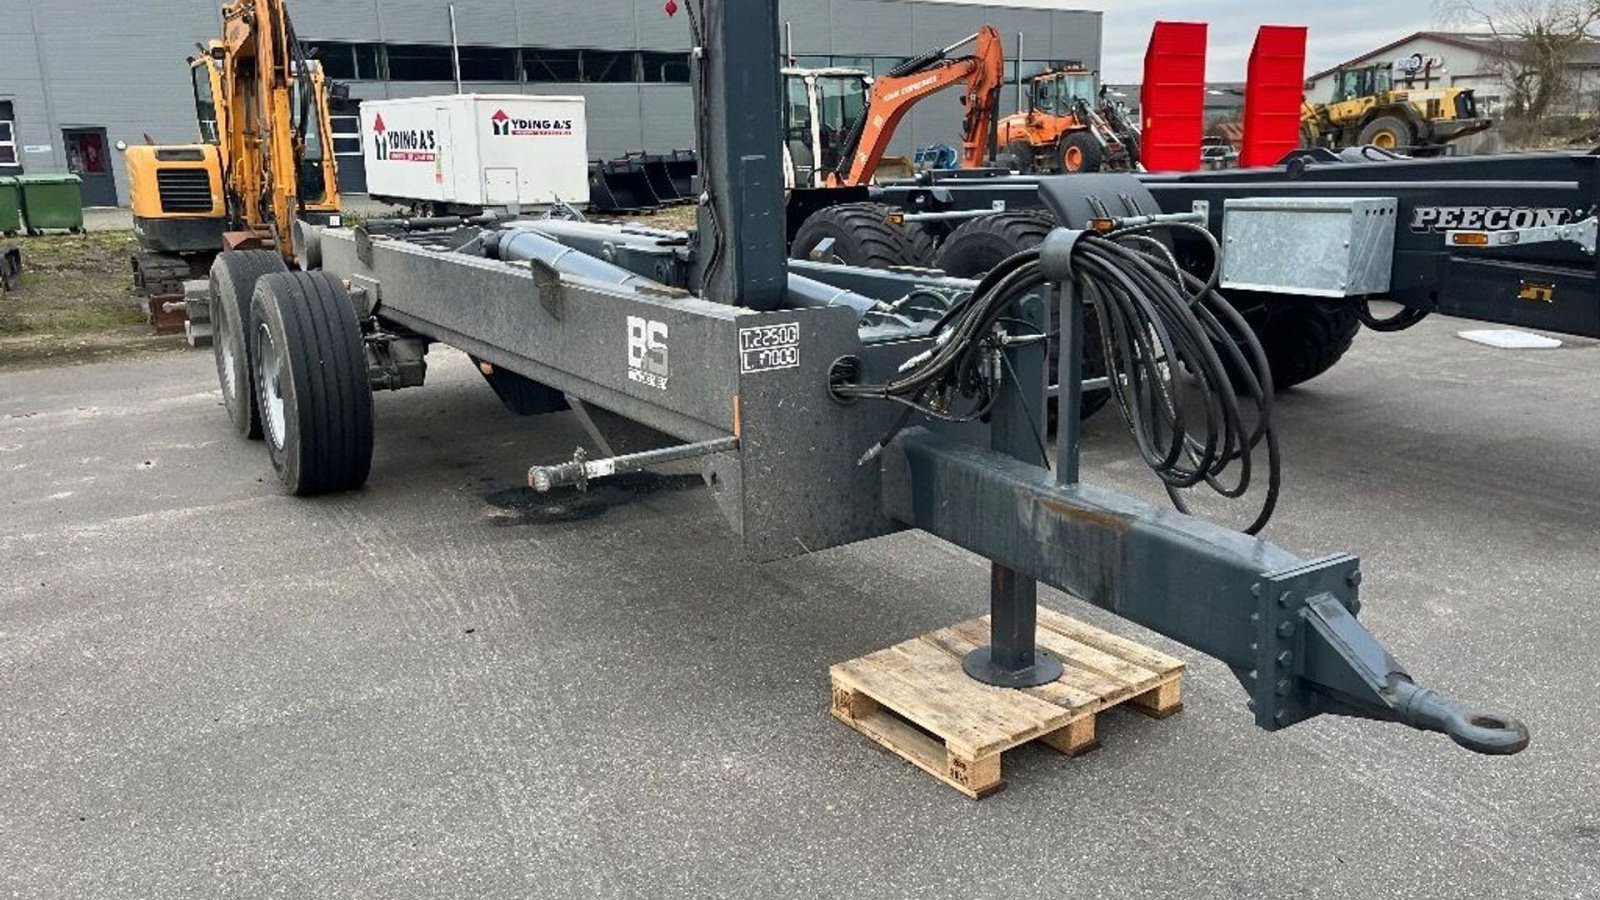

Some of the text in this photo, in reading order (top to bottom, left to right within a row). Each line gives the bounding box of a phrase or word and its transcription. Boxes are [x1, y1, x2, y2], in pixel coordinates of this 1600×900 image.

[511, 119, 551, 129] YDING
[387, 129, 418, 150] YDING
[1411, 206, 1570, 232] PEECON
[627, 315, 669, 377] BS
